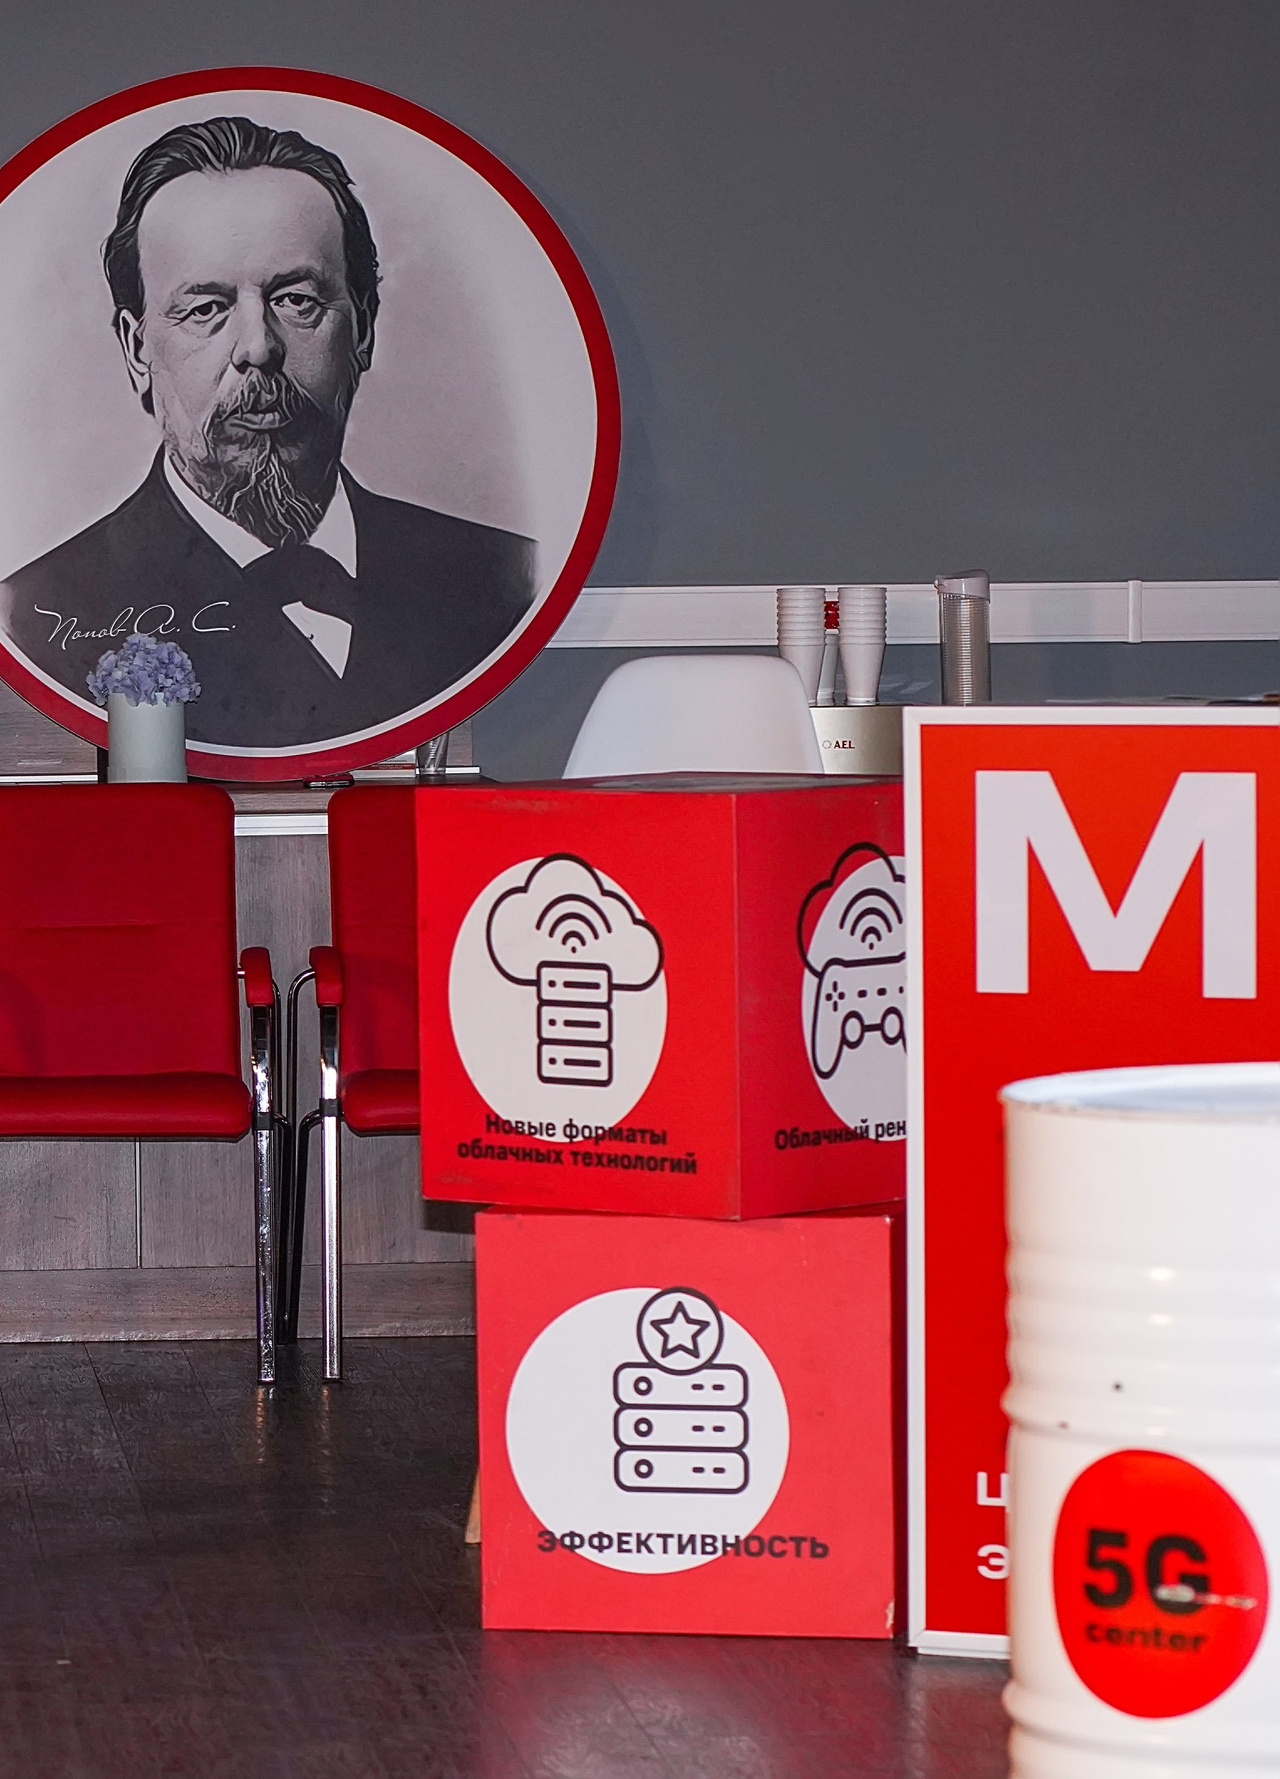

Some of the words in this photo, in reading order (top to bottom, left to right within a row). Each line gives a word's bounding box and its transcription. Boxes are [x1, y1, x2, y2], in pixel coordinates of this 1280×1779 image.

[34, 604, 134, 650] Попов
[485, 1113, 557, 1138] Новые
[563, 1118, 668, 1146] форматы
[773, 1118, 869, 1151] Облачный
[456, 1138, 564, 1165] облачных
[570, 1150, 698, 1175] технологий
[536, 1529, 830, 1559] ЭФФЕКТИВНОСТЬ
[1084, 1527, 1209, 1616] 5G
[1085, 1622, 1208, 1653] center
